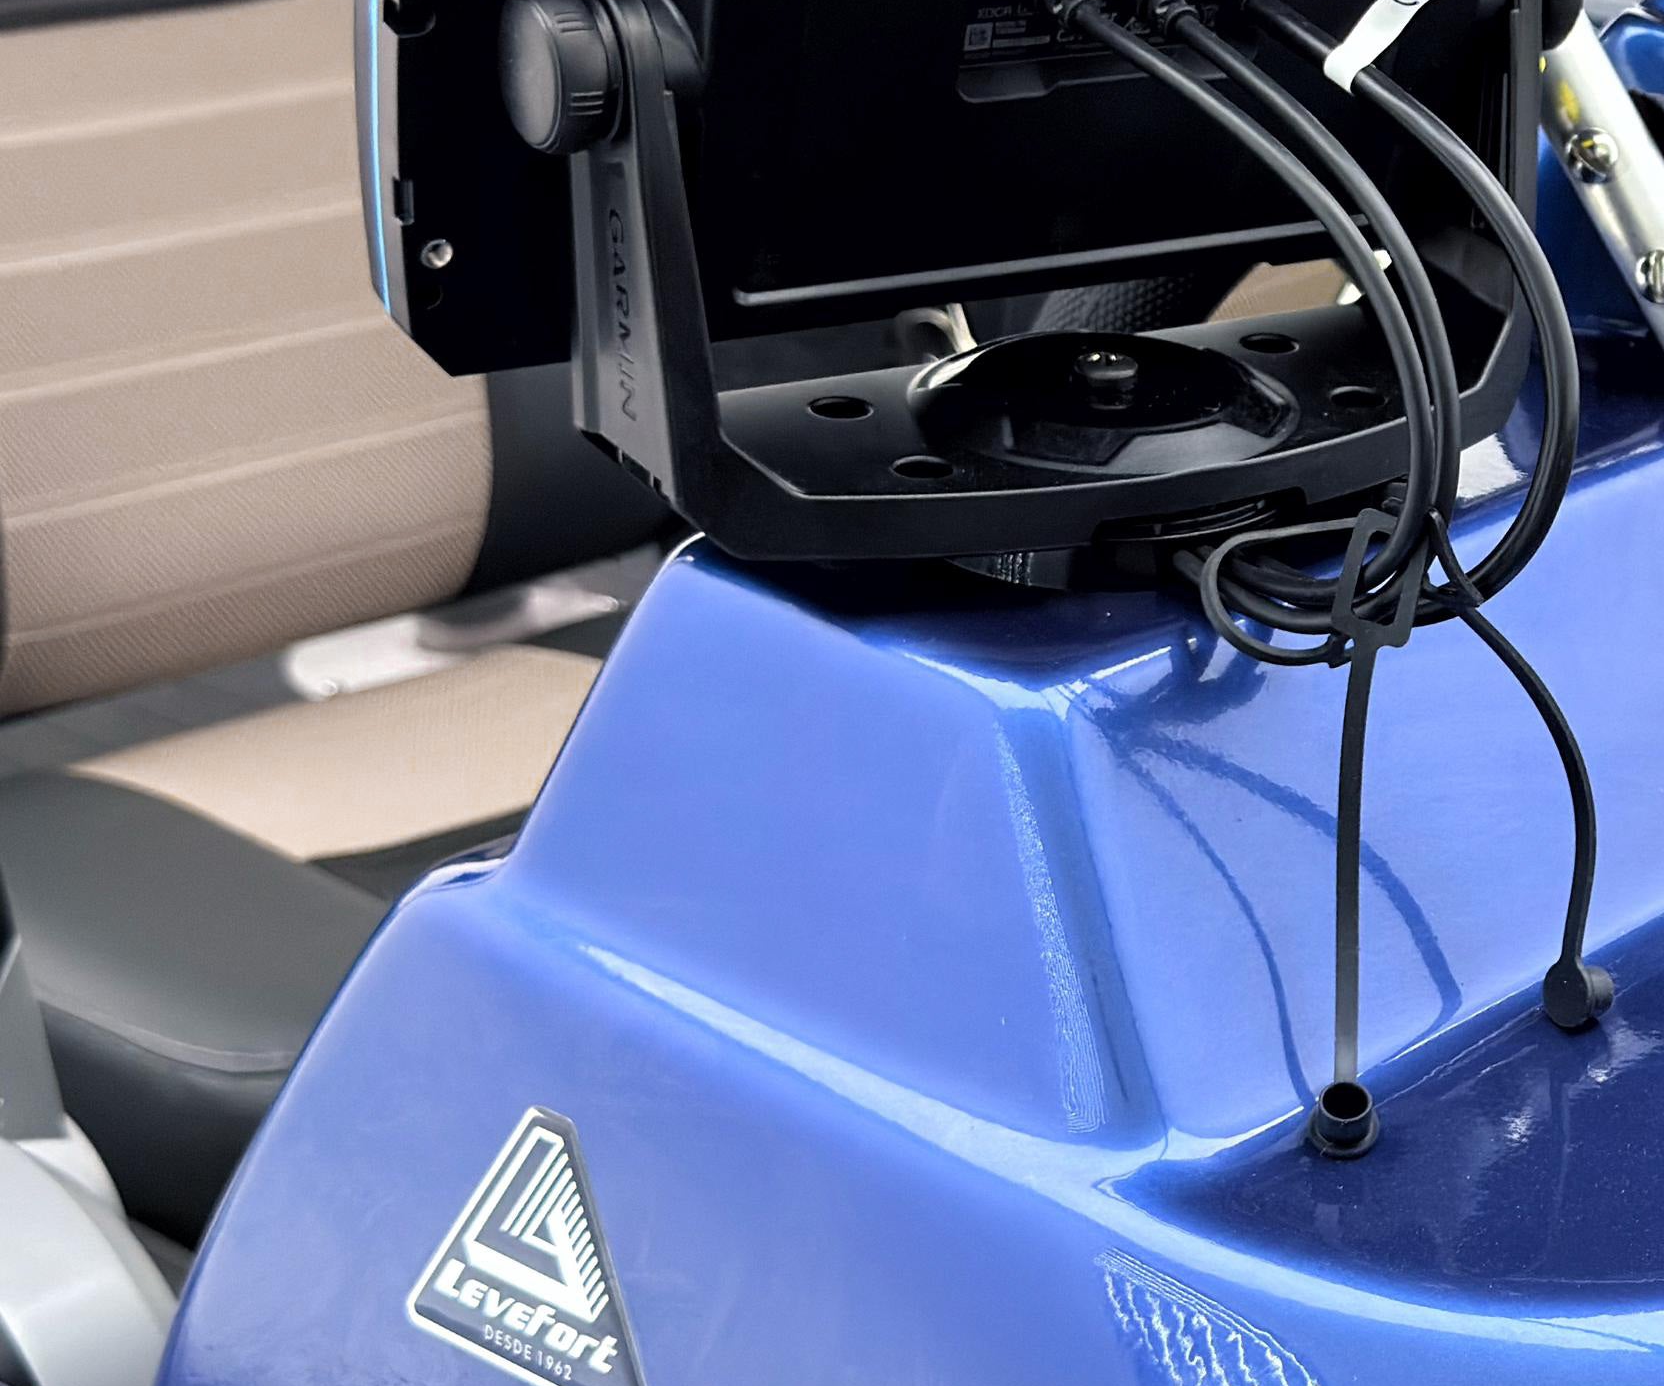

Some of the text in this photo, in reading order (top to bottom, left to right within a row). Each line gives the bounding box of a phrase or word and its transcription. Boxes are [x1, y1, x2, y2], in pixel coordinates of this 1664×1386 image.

[608, 207, 637, 422] GARMIN
[484, 1324, 574, 1381] DESDE 1962
